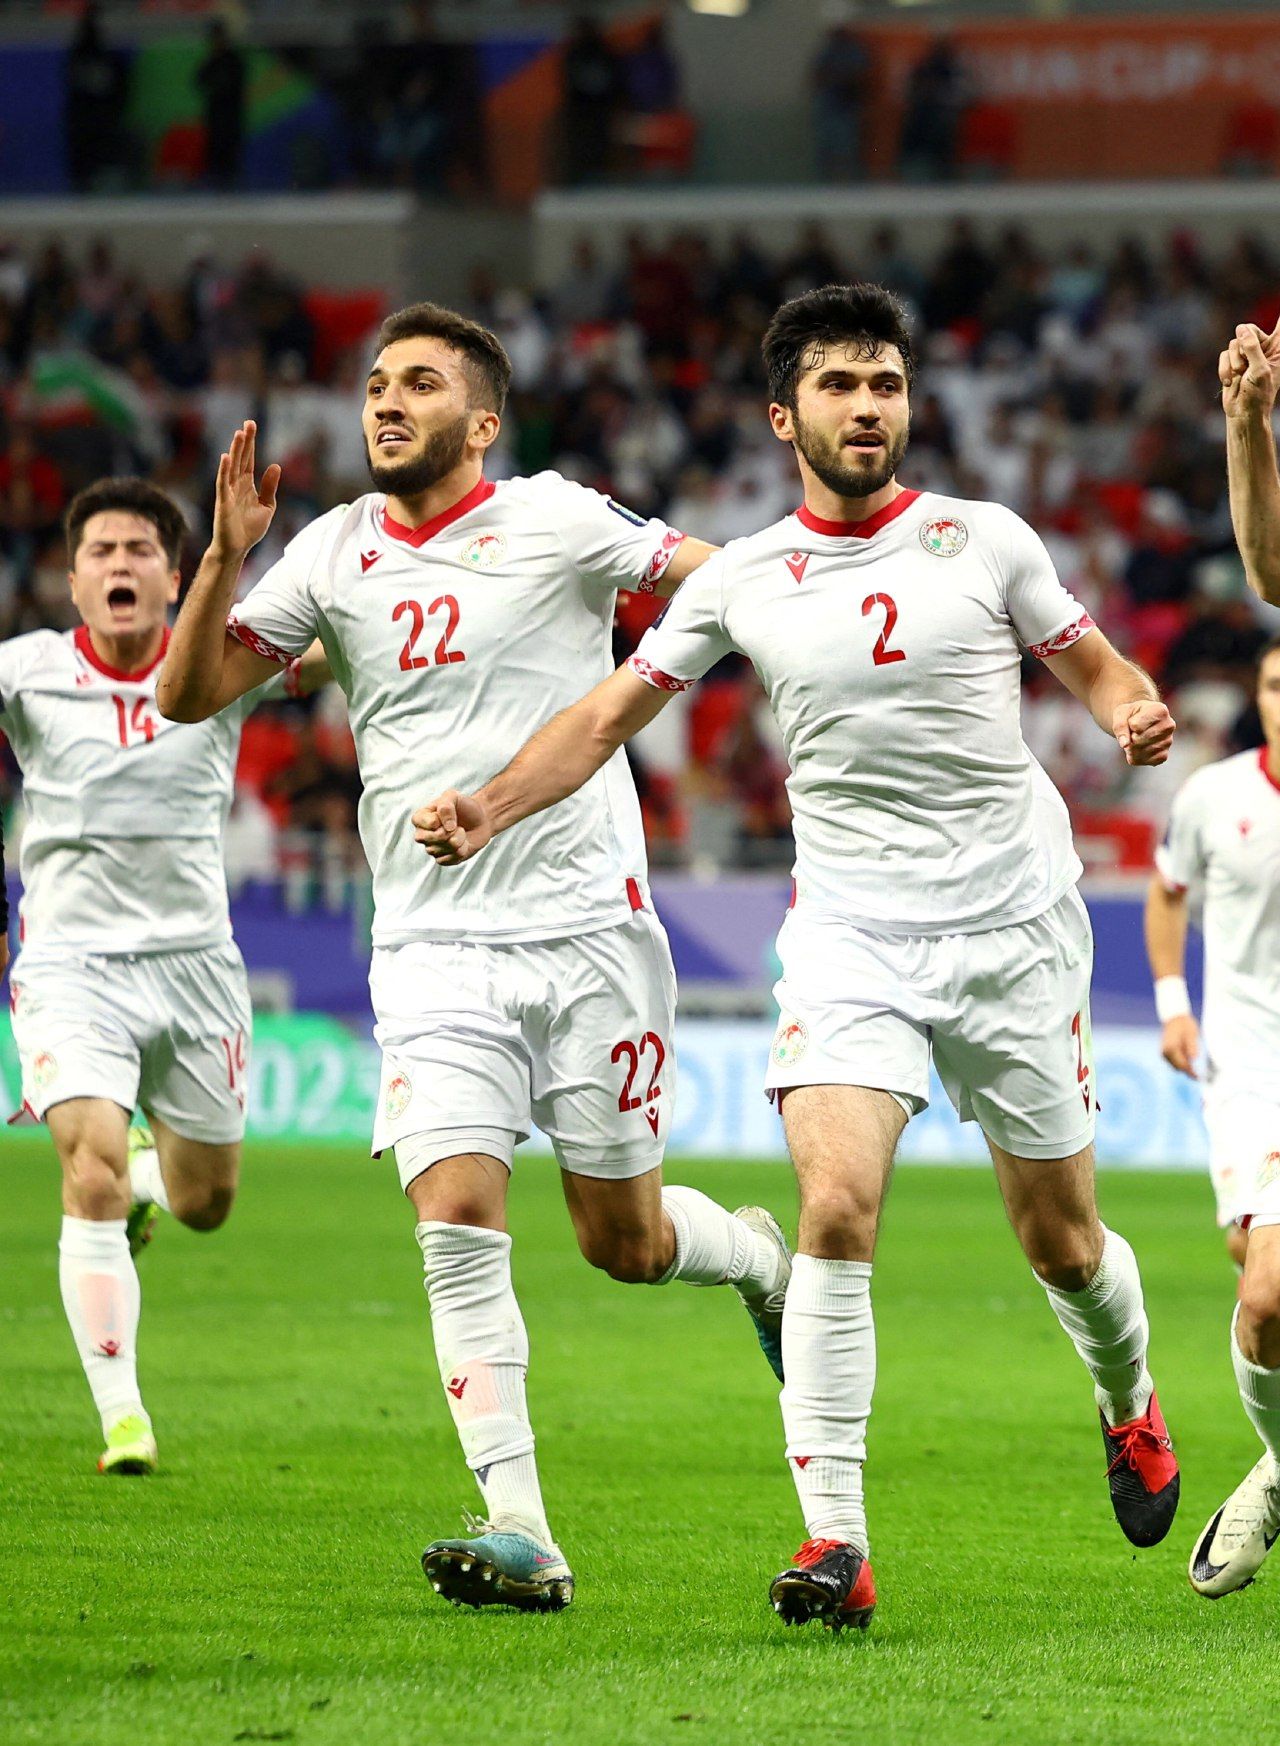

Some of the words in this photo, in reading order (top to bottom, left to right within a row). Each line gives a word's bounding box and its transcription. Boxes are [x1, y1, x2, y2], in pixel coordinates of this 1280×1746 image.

[391, 594, 466, 672] 22
[861, 592, 906, 666] 2
[112, 694, 159, 749] 14
[610, 1031, 666, 1113] 22
